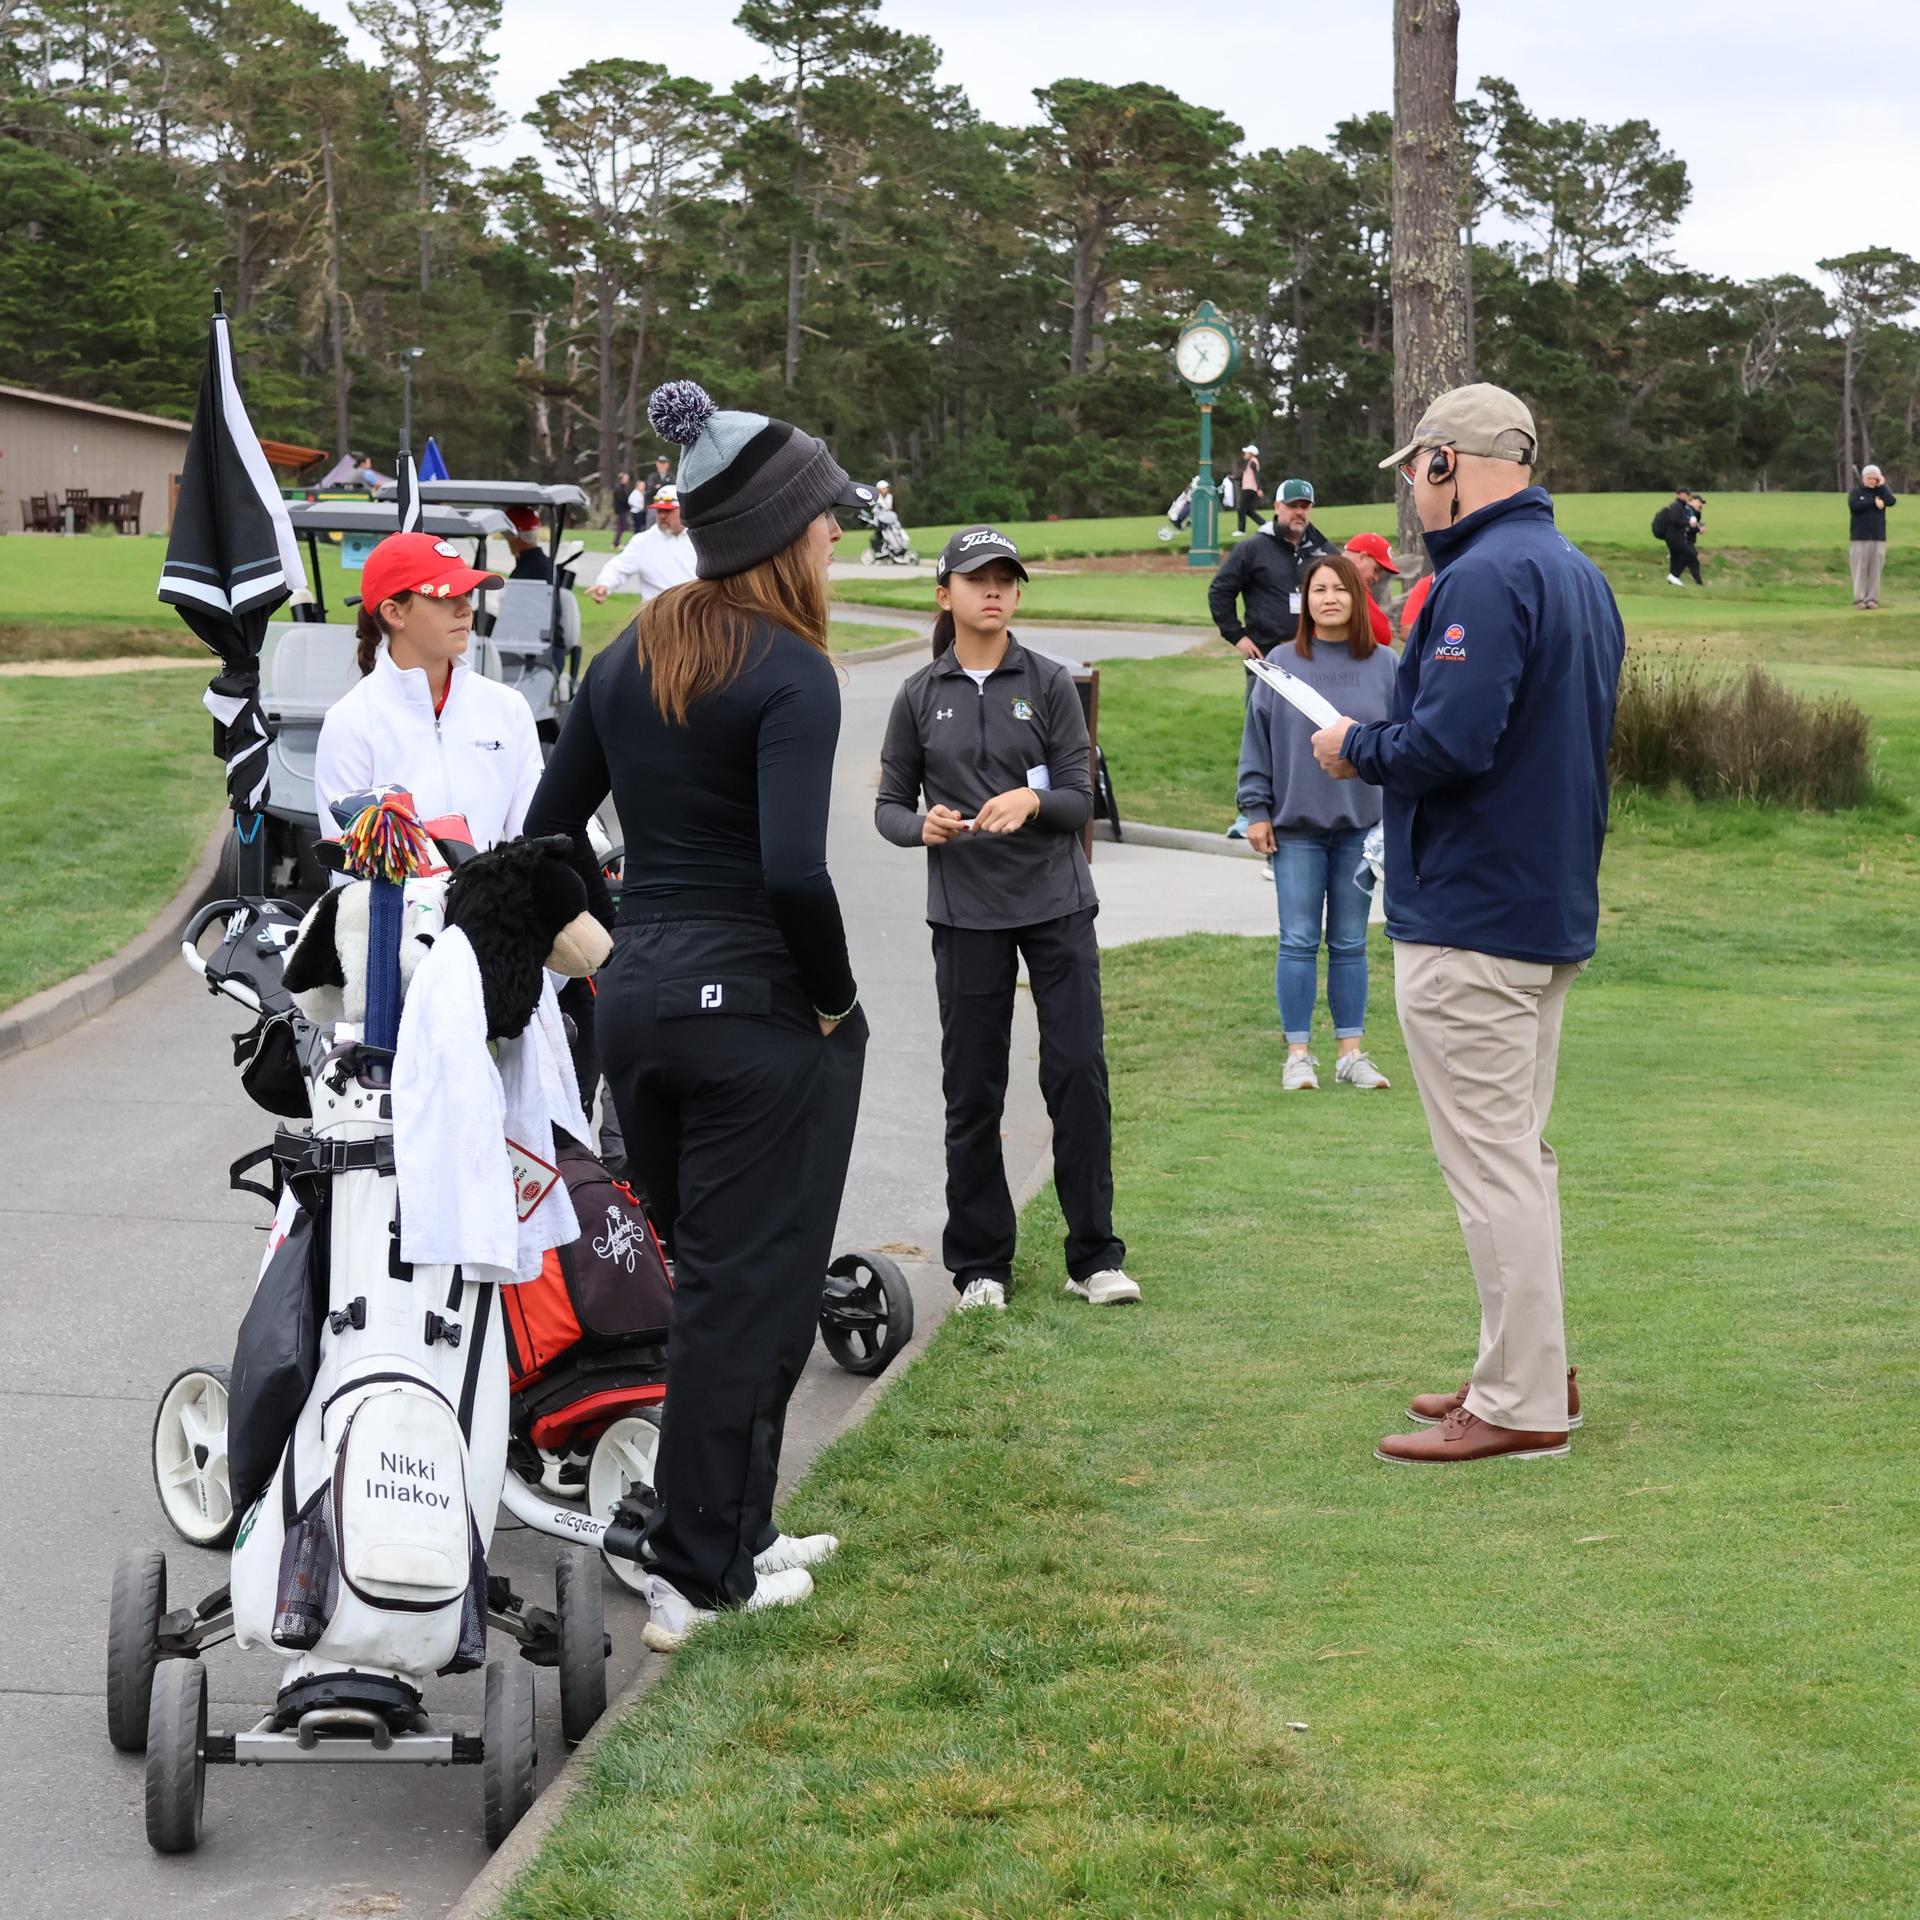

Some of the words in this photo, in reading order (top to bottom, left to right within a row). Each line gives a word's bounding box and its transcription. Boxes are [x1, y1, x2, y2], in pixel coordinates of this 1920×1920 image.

[1435, 646, 1466, 657] NCGA
[701, 984, 722, 1008] FJ
[380, 1451, 435, 1481] Nikki
[366, 1479, 450, 1509] Iniakov
[554, 1511, 606, 1534] clicgear
